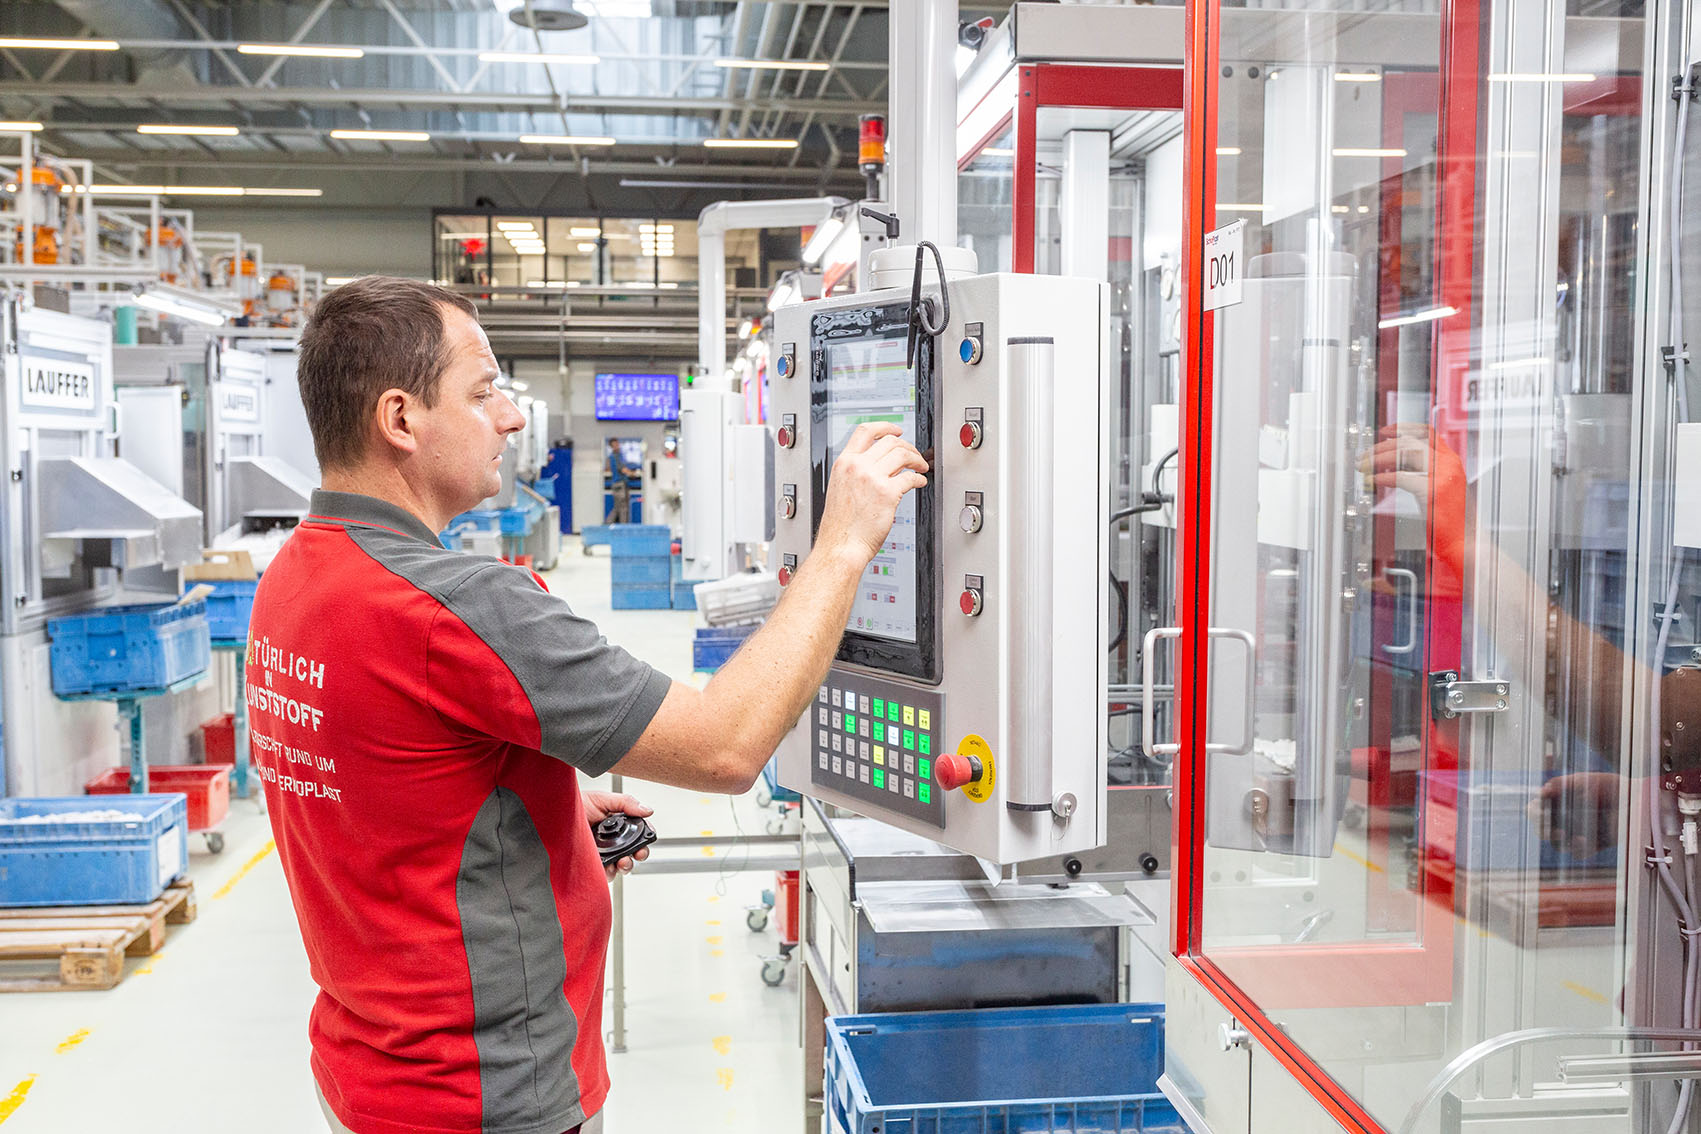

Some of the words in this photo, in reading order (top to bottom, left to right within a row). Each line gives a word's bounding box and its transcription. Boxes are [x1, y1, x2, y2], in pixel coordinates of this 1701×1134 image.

[1210, 250, 1234, 290] D01
[27, 368, 89, 398] LAUFFER
[246, 630, 325, 689] ATÜRLICH
[264, 670, 273, 688] IN
[246, 681, 324, 732] UNSTSTOFF
[314, 755, 336, 773] UM
